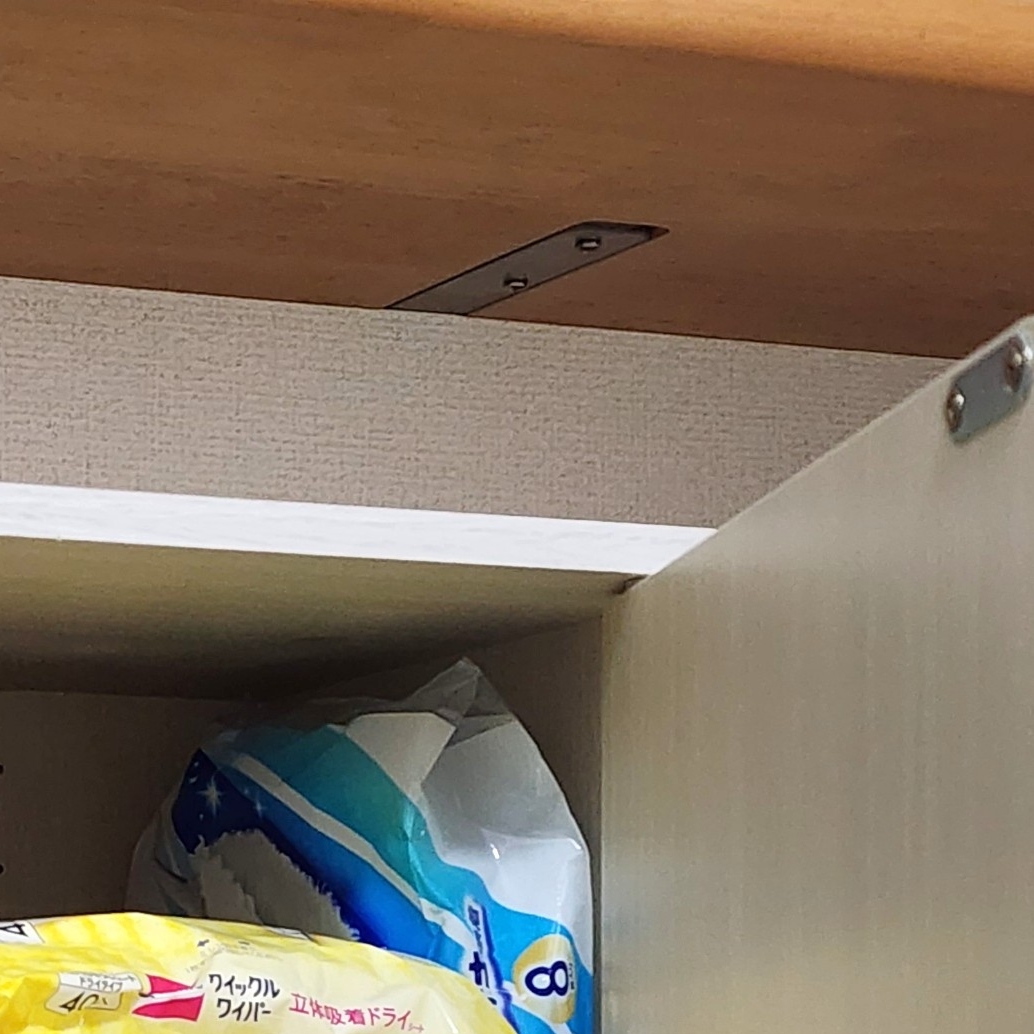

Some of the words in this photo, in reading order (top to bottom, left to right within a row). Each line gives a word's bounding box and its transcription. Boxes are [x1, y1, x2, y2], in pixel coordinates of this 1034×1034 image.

[525, 960, 568, 996] 8
[217, 998, 272, 1022] ワイパー
